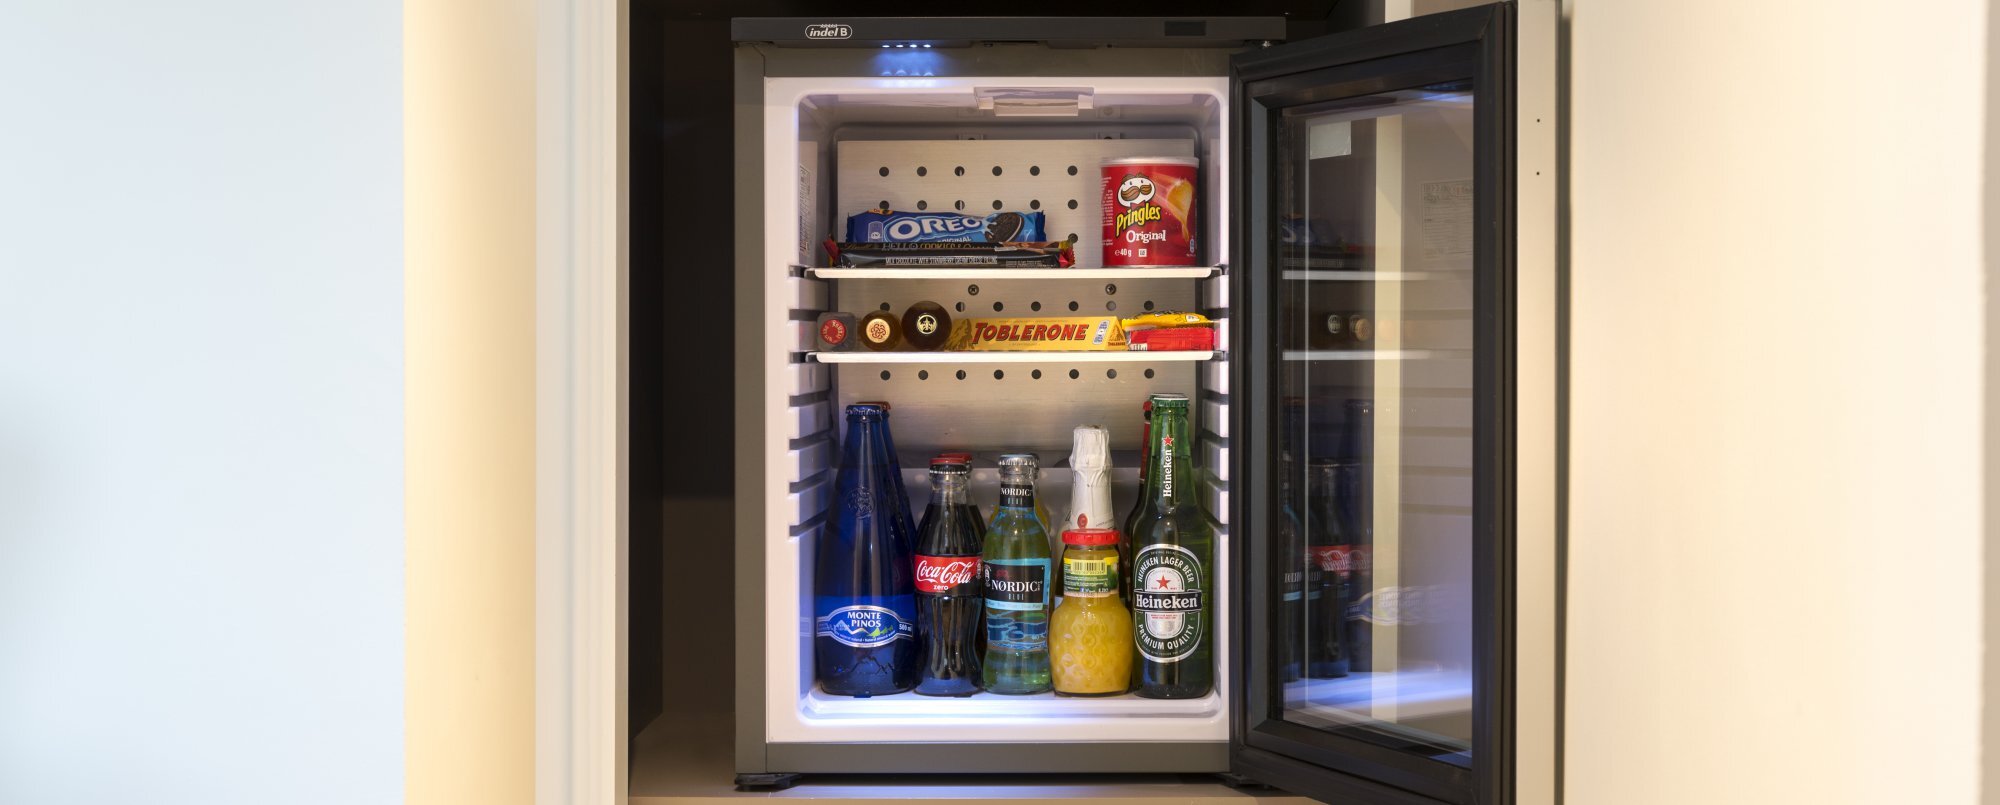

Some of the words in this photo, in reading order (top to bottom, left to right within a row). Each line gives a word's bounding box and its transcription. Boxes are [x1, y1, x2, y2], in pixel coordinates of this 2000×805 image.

[809, 27, 838, 37] indel
[840, 27, 848, 37] B
[889, 217, 981, 240] OREO
[1115, 202, 1161, 237] Pringles
[1126, 229, 1167, 243] Original
[972, 322, 1089, 344] TOBLERONE
[1162, 449, 1172, 497] Heineken
[916, 560, 975, 584] Coca-Cola
[1137, 556, 1159, 583] HEINEKEN
[1160, 556, 1184, 569] LAGER
[1182, 565, 1195, 583] BEER
[1136, 593, 1198, 609] Heineken
[847, 611, 882, 620] MONTE
[851, 619, 882, 628] PINOS
[1138, 624, 1165, 650] PREMIUM
[1167, 624, 1195, 650] QUALITY
